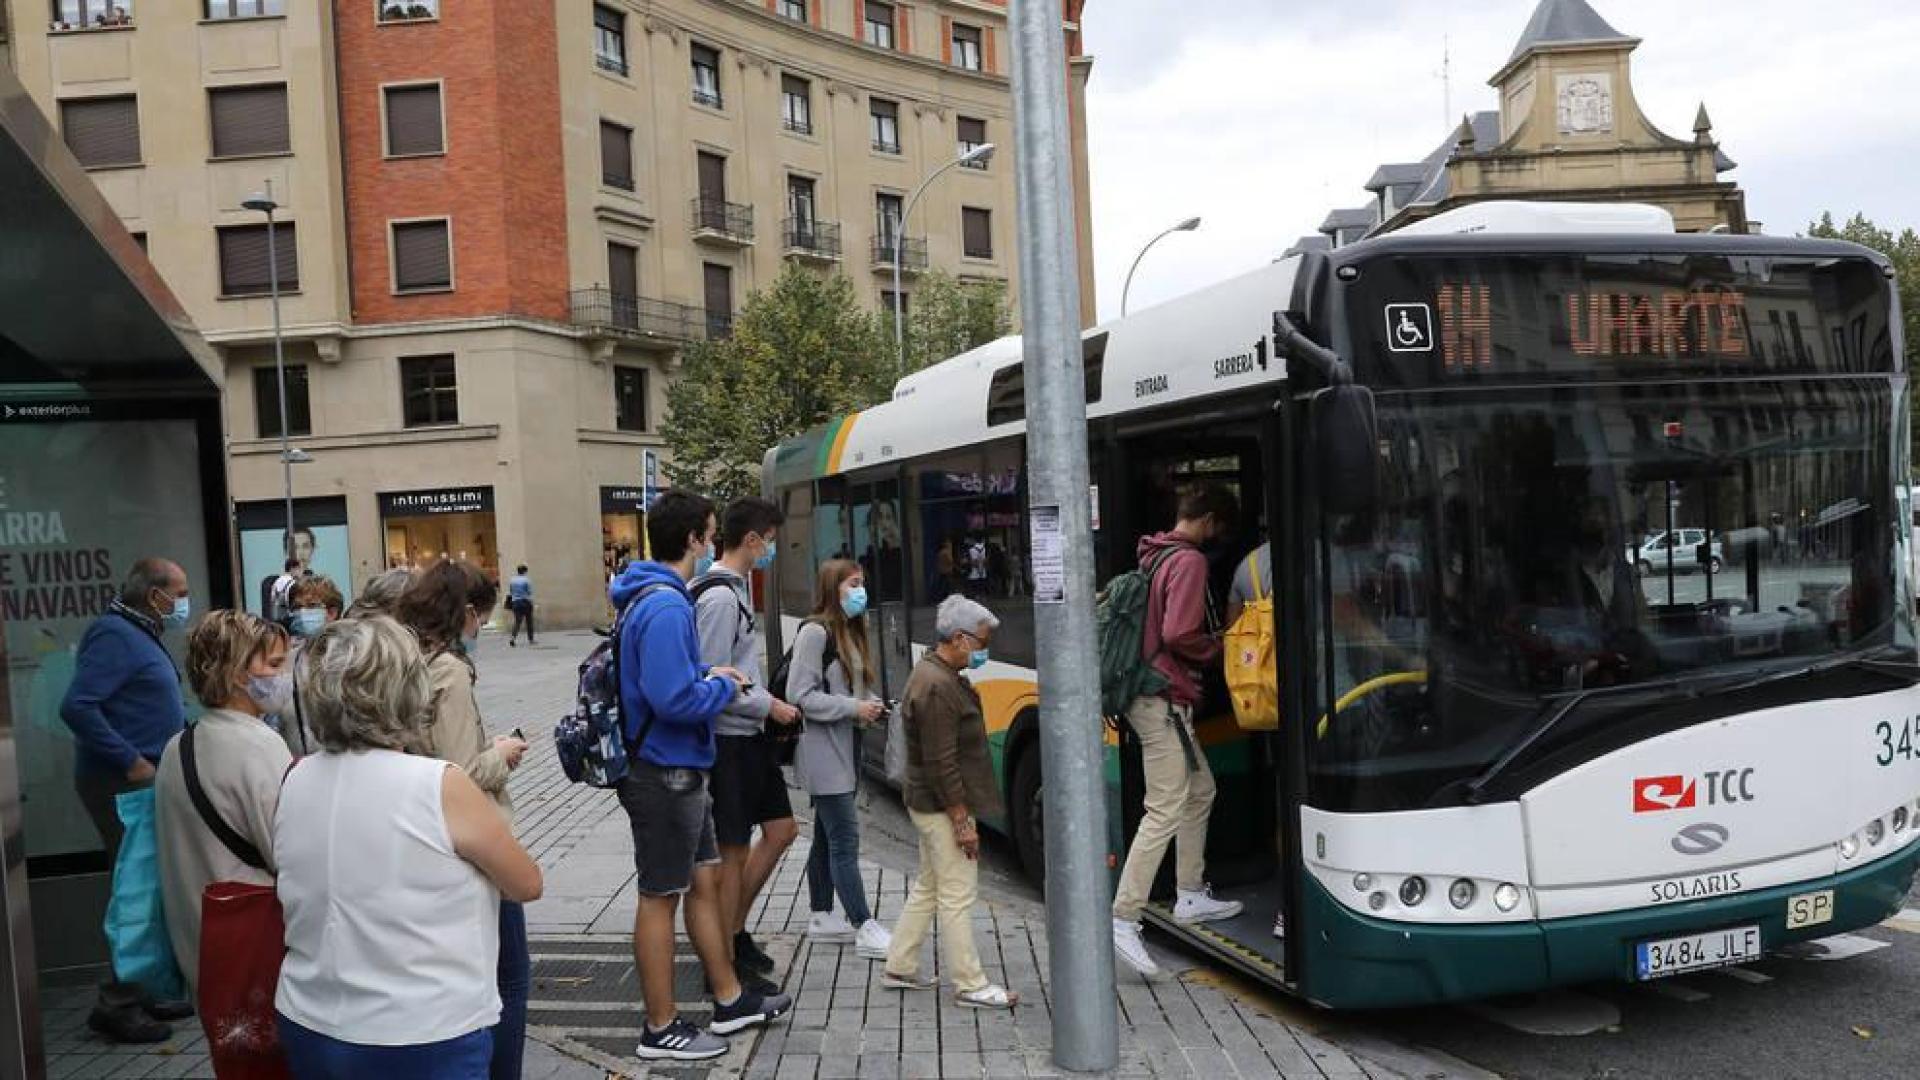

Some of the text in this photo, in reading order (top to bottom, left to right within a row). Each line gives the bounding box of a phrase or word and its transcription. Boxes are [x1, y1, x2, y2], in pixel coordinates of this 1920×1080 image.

[1569, 292, 1746, 354] UHARTE
[1213, 353, 1254, 378] SARRERA
[1134, 374, 1169, 398] ENTRADA
[393, 491, 482, 506] intimissimi
[21, 548, 112, 584] VINOS
[3, 583, 126, 621] NAVARR
[1704, 768, 1754, 806] TCC
[1651, 872, 1742, 903] SOLARIS
[1651, 930, 1756, 970] 3484 JLF
